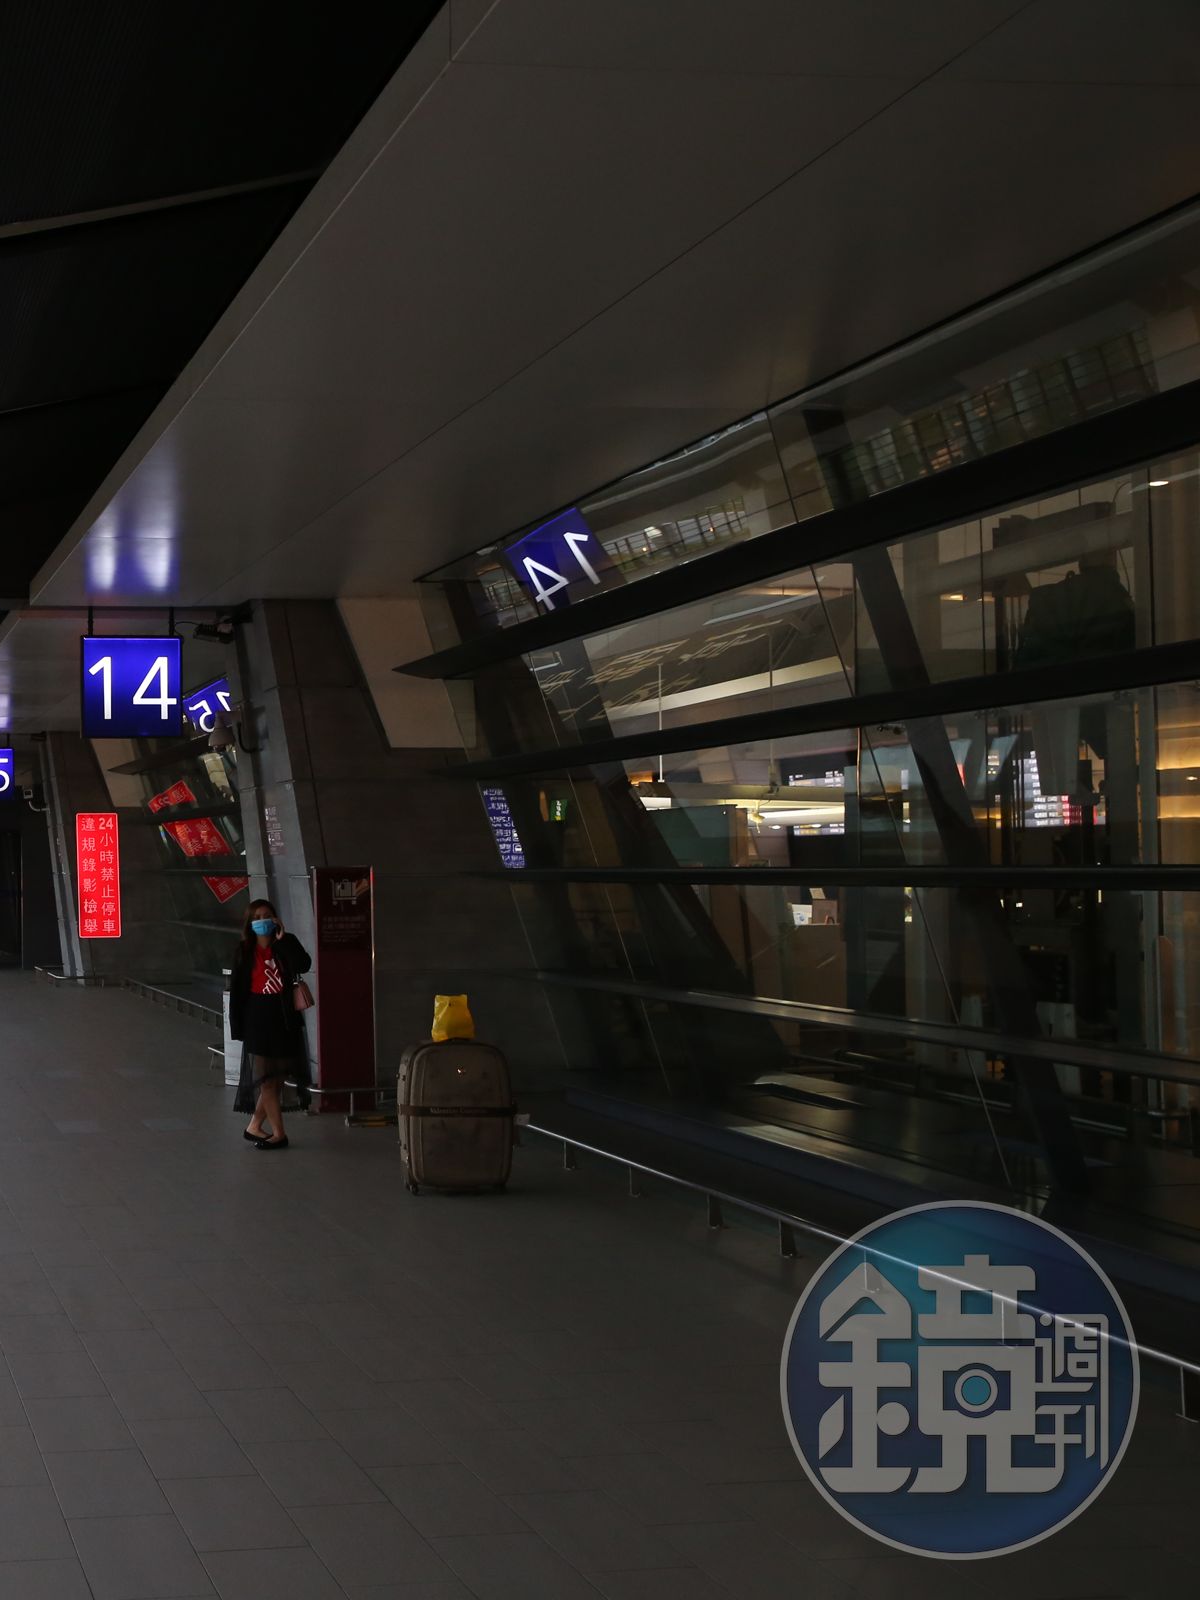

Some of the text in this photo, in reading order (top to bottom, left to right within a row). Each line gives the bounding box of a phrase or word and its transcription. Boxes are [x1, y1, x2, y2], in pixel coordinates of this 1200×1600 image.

[88, 655, 177, 721] 14
[81, 817, 98, 933] 違規錄影檢舉
[99, 817, 116, 933] 24小時禁止停車
